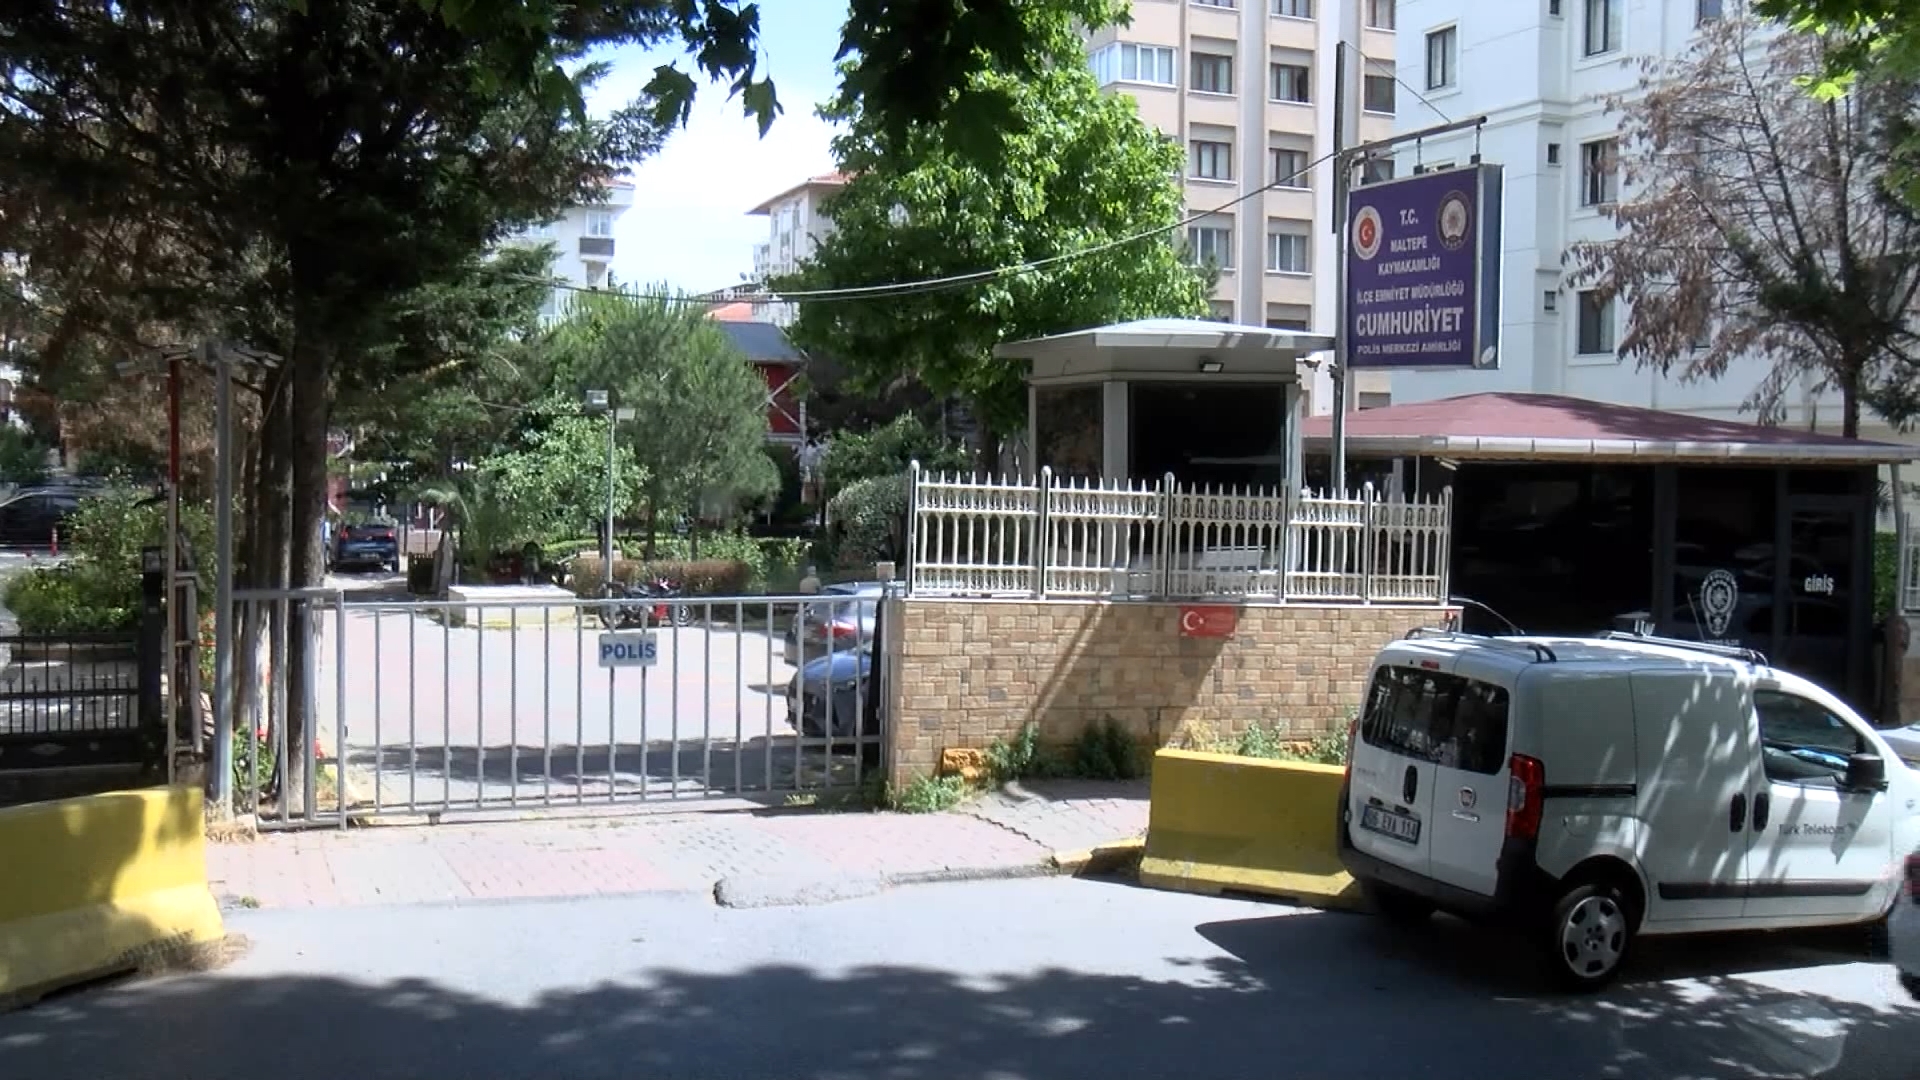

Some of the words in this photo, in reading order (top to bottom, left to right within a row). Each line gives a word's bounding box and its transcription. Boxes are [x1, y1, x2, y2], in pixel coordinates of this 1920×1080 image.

[1400, 209, 1418, 225] T.C.
[1390, 236, 1428, 252] MALTEPE
[1378, 255, 1440, 275] KAYMAKAMLIĞI
[1356, 287, 1374, 305] İLÇE
[1375, 285, 1410, 303] EMNİYET
[1411, 280, 1464, 298] MÜDÜRLÜĞÜ
[1356, 303, 1464, 337] CUMHURİYET
[1357, 343, 1381, 355] POLİS
[1382, 342, 1420, 354] MERKEZİ
[1421, 339, 1462, 353] AMİRLİĞİ
[1804, 573, 1835, 595] GİRİŞ
[602, 640, 656, 659] POLİS
[1803, 823, 1845, 835] Telekom
